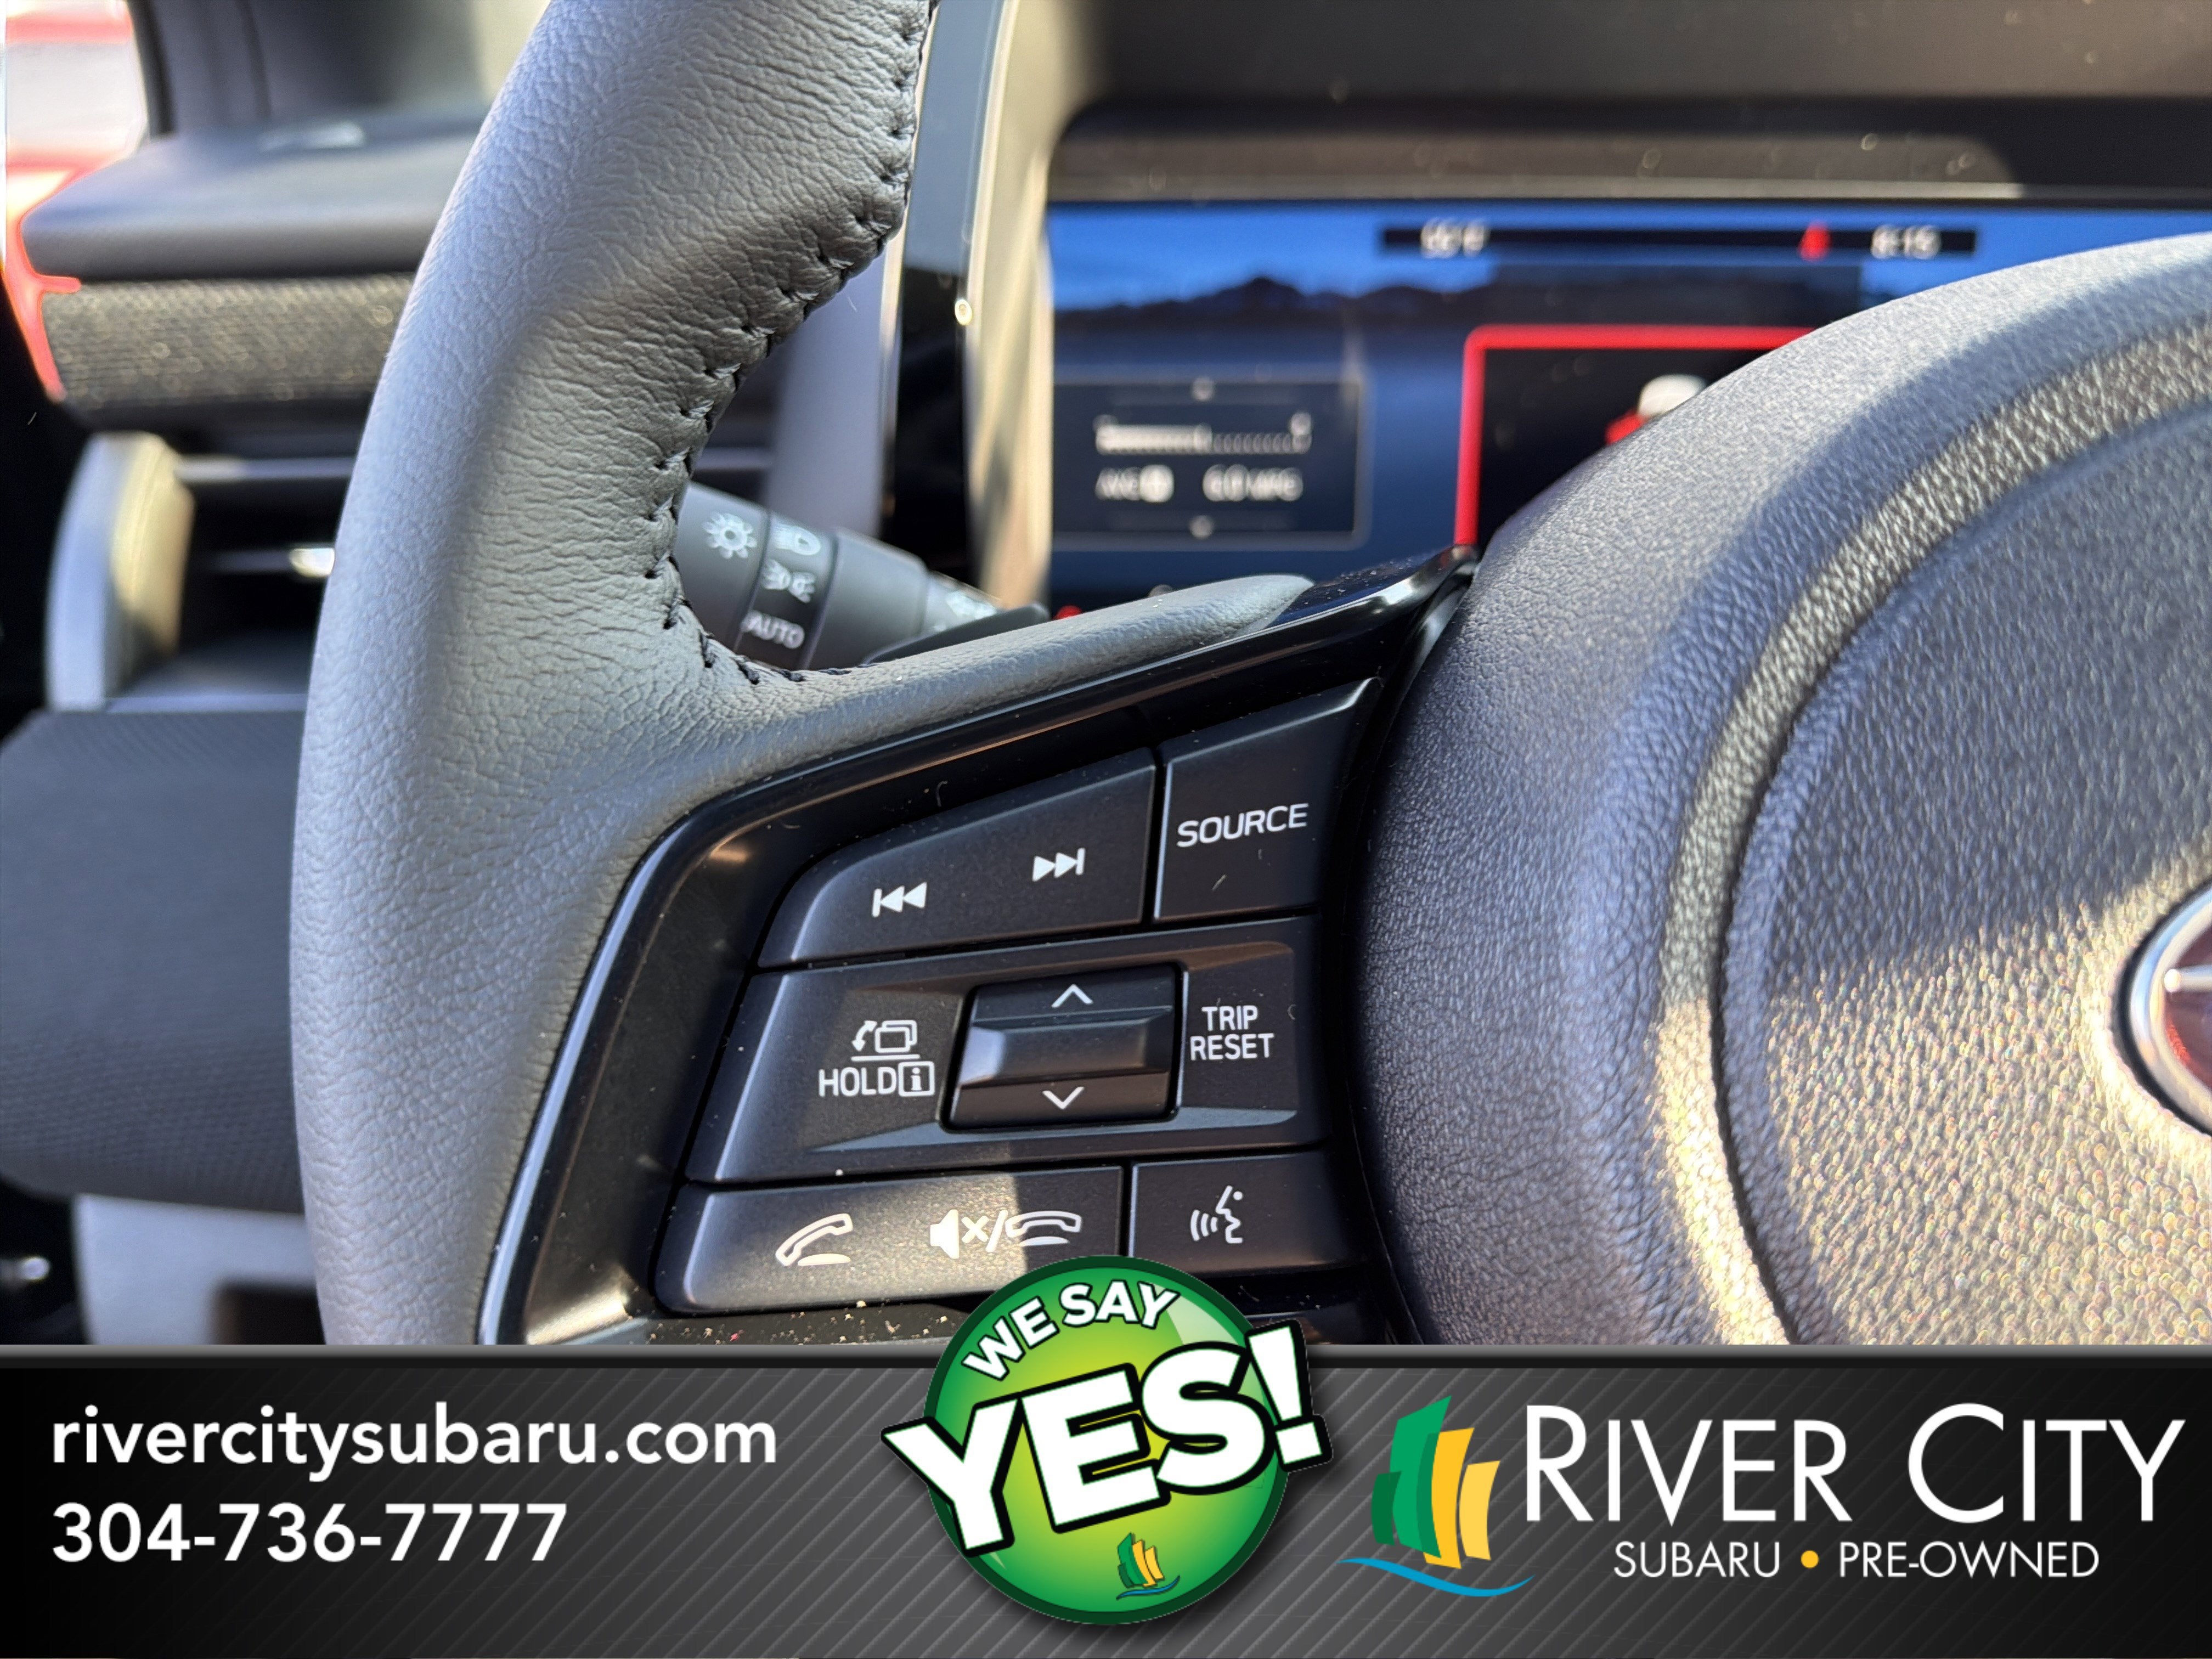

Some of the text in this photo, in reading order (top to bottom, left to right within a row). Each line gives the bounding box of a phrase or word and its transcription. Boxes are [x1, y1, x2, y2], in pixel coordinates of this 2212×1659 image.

[741, 609, 805, 650] AUTO
[1176, 803, 1308, 848] SOURCE
[1201, 1005, 1259, 1031] TRIP
[1190, 1032, 1274, 1061] RESET
[819, 1066, 897, 1098] HOLD
